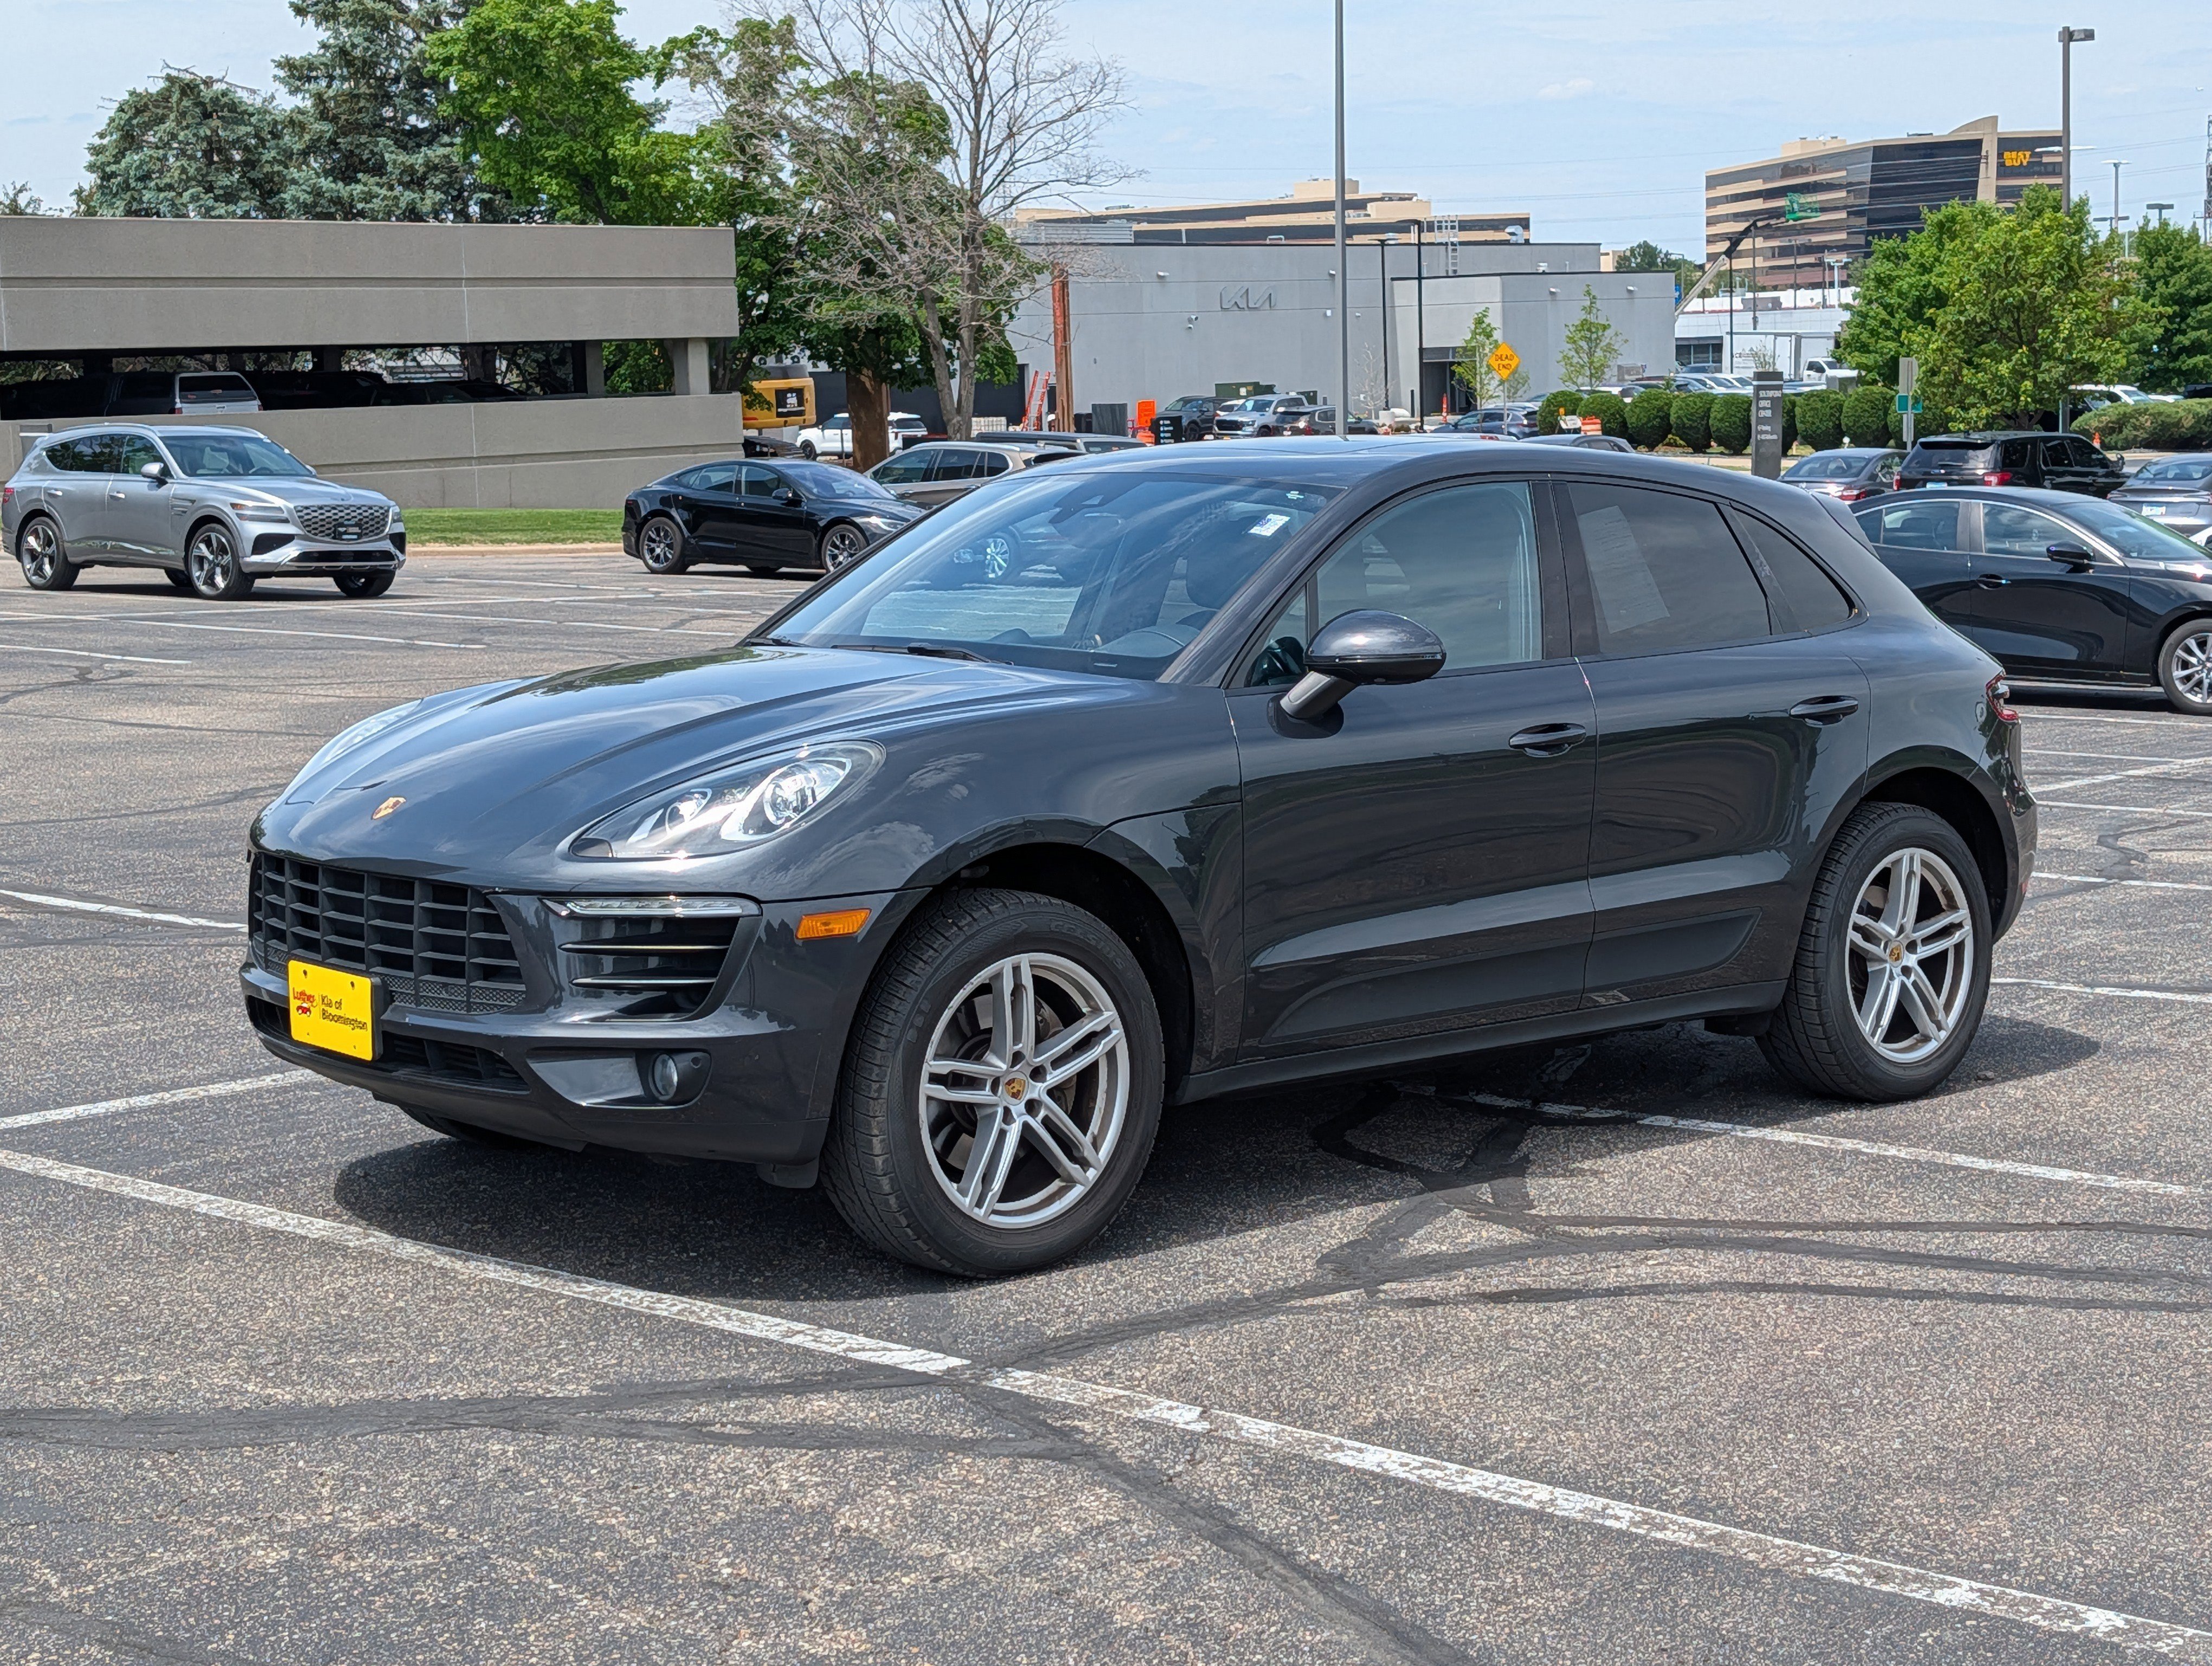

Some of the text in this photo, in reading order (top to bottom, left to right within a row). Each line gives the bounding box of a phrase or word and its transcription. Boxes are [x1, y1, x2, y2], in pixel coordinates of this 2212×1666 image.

[2004, 151, 2031, 159] BEST
[2005, 158, 2029, 166] BUY
[1495, 354, 1515, 362] DEAD
[1497, 363, 1512, 371] END
[321, 994, 342, 1010] Kia of
[321, 1008, 368, 1031] Bloomington
